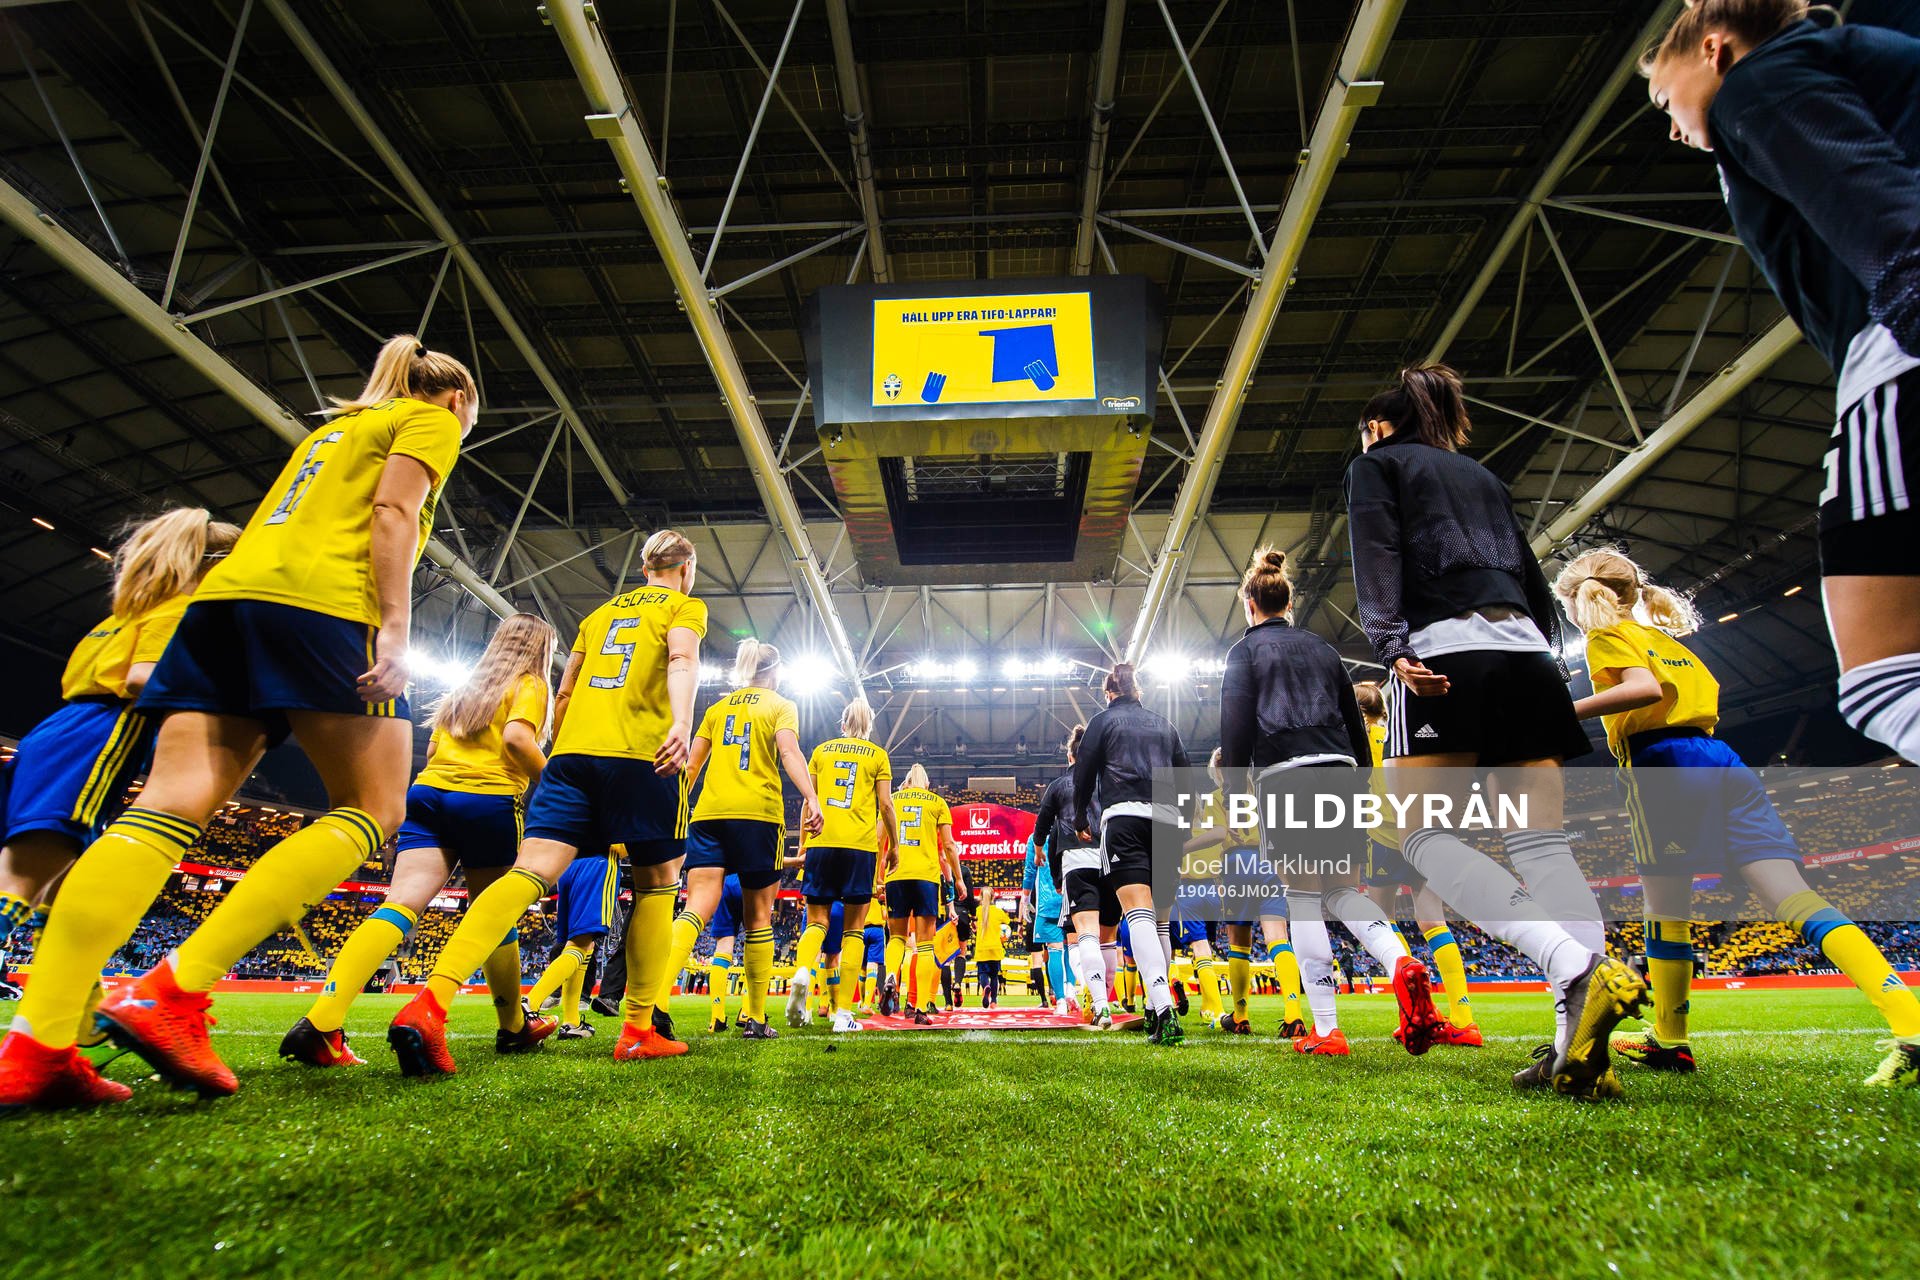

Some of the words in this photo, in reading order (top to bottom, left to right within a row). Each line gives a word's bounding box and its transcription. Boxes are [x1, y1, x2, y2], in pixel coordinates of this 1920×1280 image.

[932, 311, 954, 322] UPP
[957, 310, 978, 321] ERA
[981, 307, 1057, 320] TIFO-LAPPAR!
[589, 617, 640, 689] 5
[729, 693, 761, 706] GLAS
[723, 714, 752, 771] 4
[822, 743, 876, 757] SEMBRANT
[826, 760, 858, 809] 3
[899, 805, 922, 846] 2
[969, 840, 1011, 855] svensk
